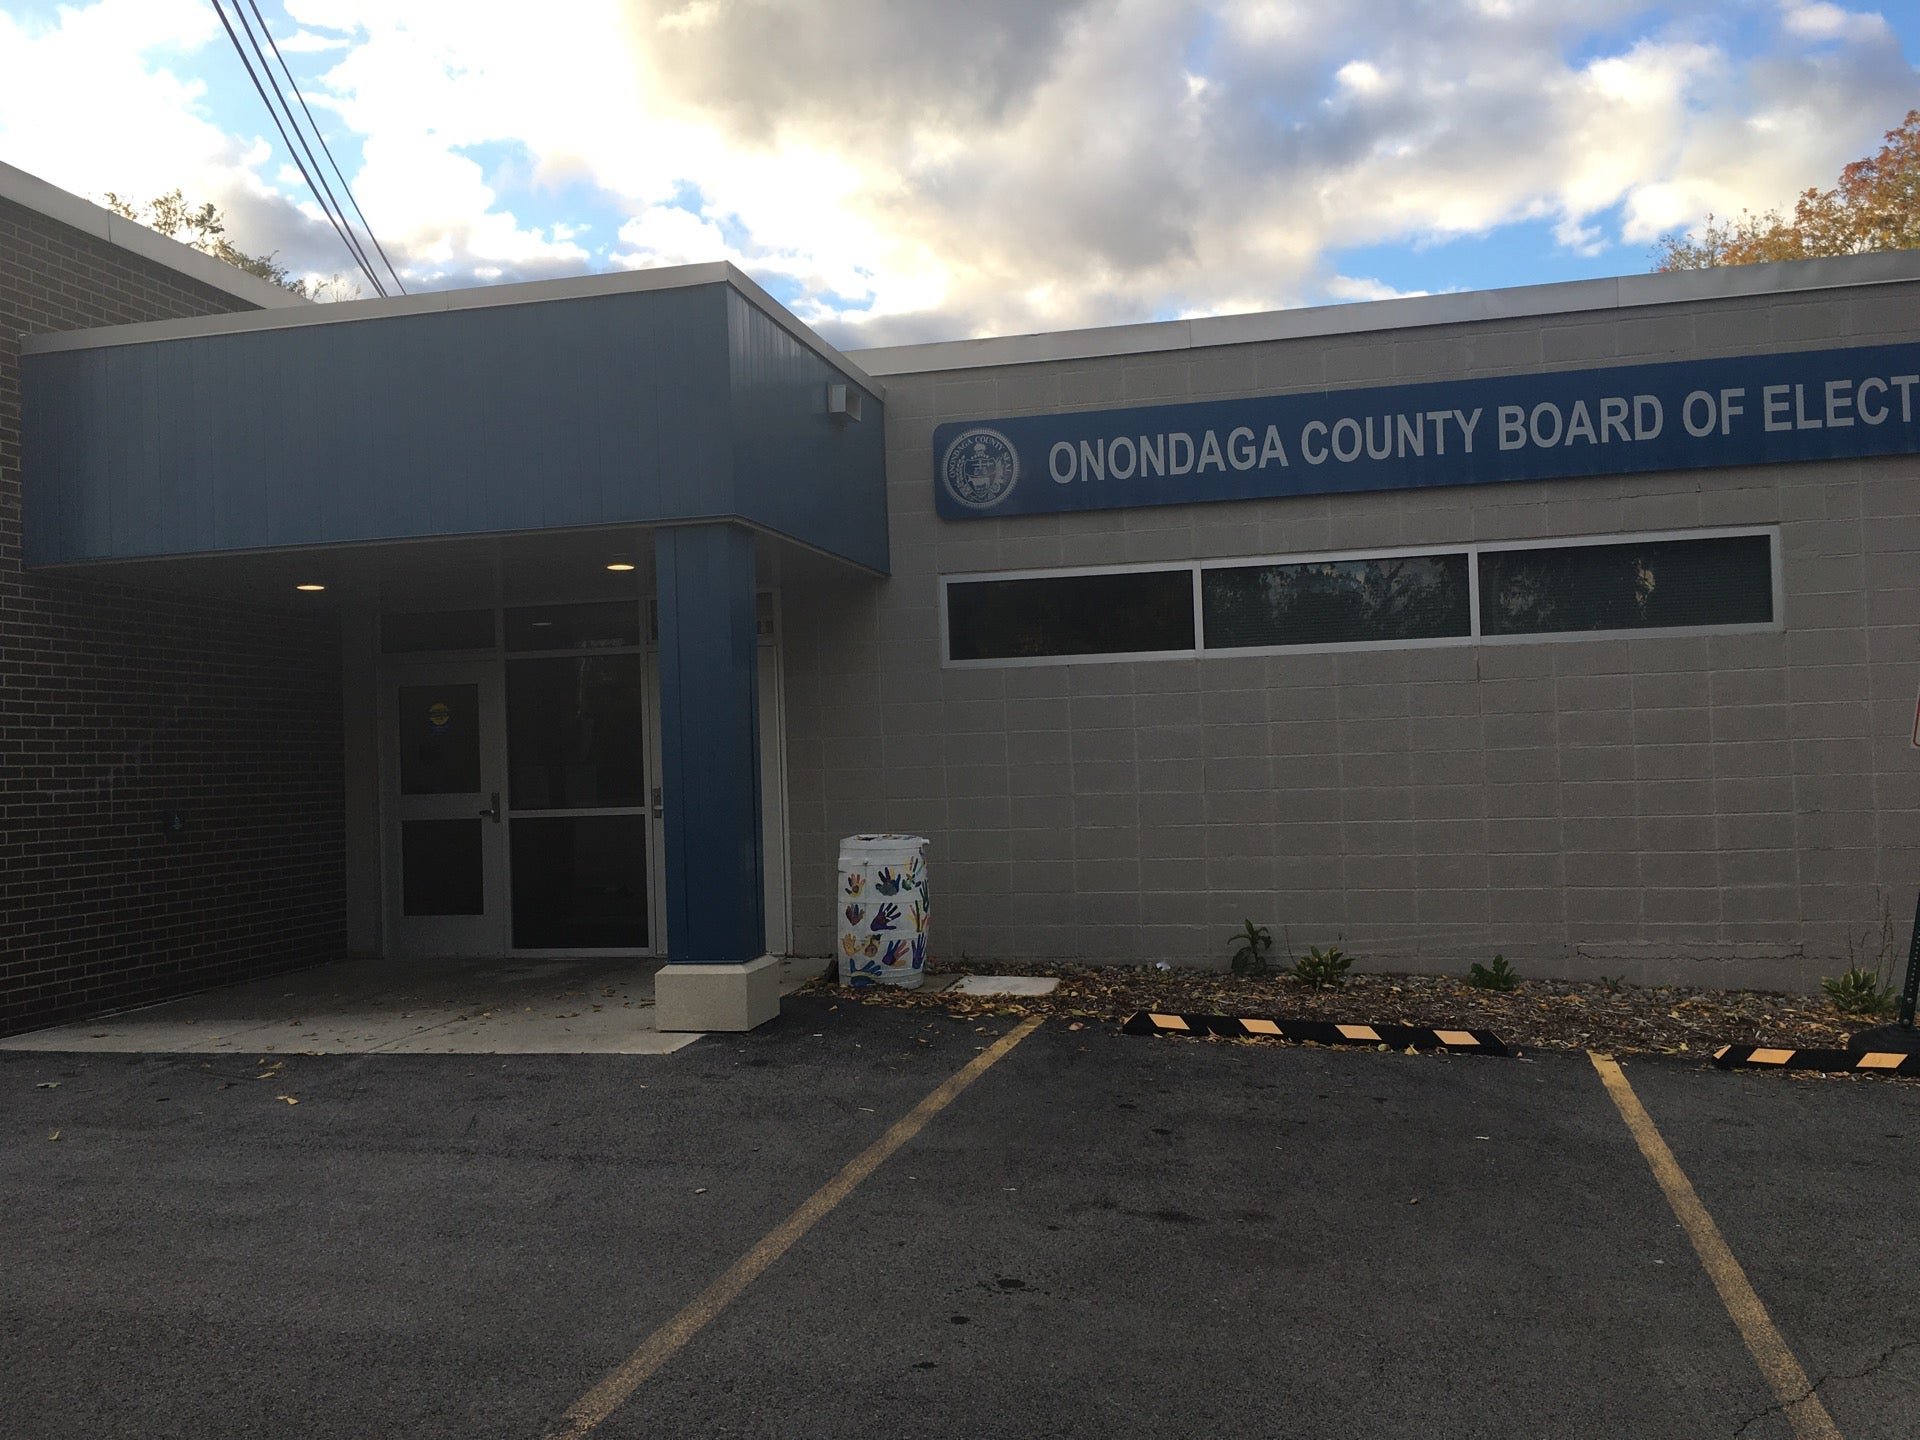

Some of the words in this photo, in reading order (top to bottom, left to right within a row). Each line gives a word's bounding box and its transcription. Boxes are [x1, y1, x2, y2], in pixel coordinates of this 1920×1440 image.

[949, 438, 974, 478] ONONDAGA
[975, 435, 1005, 450] COUNTY
[1003, 452, 1012, 473] SEAL
[1049, 424, 1289, 484] ONONDAGA
[1301, 407, 1483, 465] COUNTY
[1498, 394, 1664, 451] BOARD
[1682, 387, 1746, 437] OF
[1763, 374, 1920, 432] ELECT
